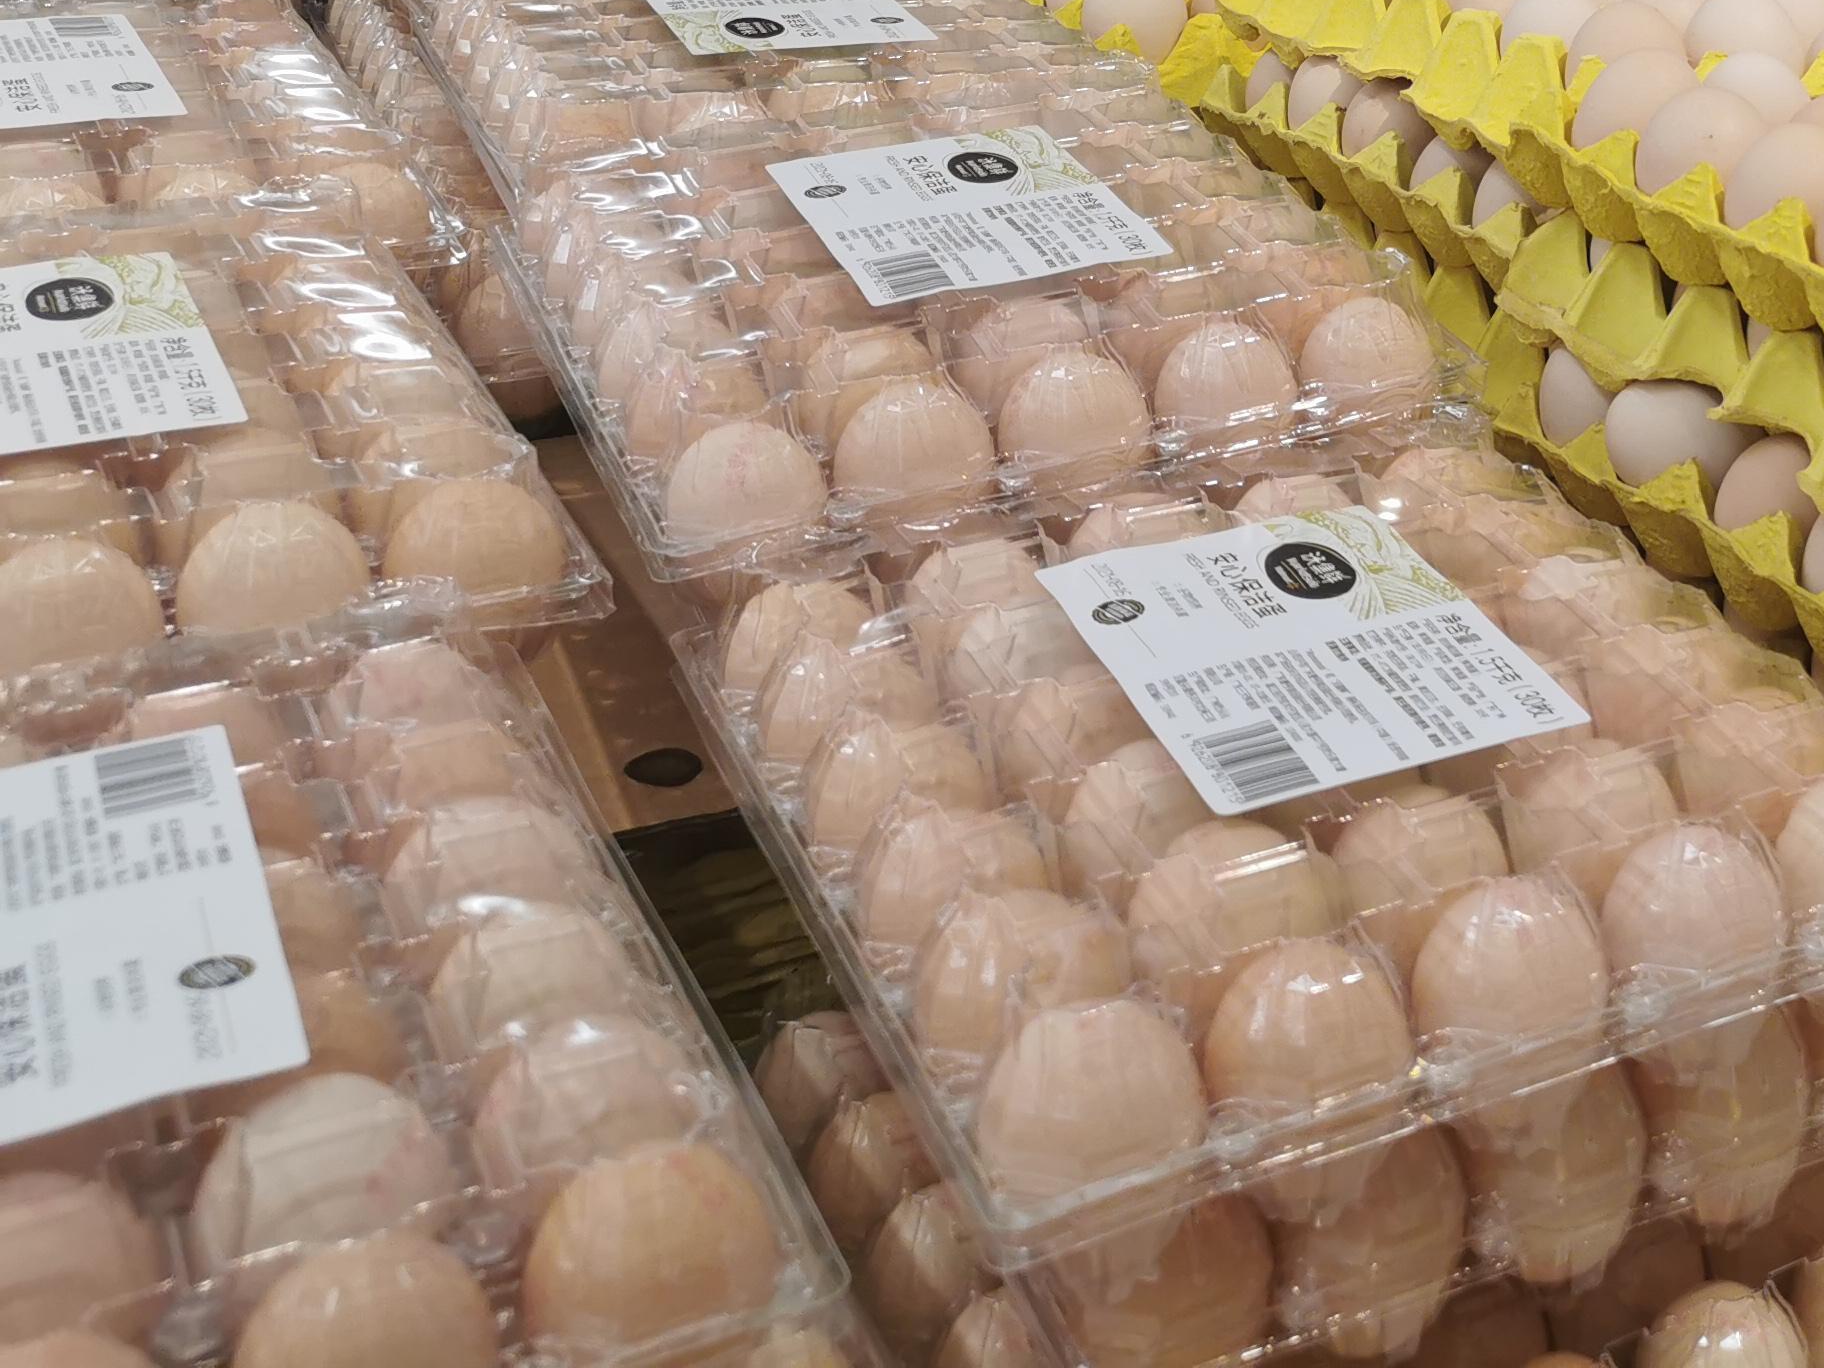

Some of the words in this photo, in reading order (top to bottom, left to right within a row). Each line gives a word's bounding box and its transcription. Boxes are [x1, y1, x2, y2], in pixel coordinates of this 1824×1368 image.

[1205, 552, 1288, 619] 安心保洁蛋
